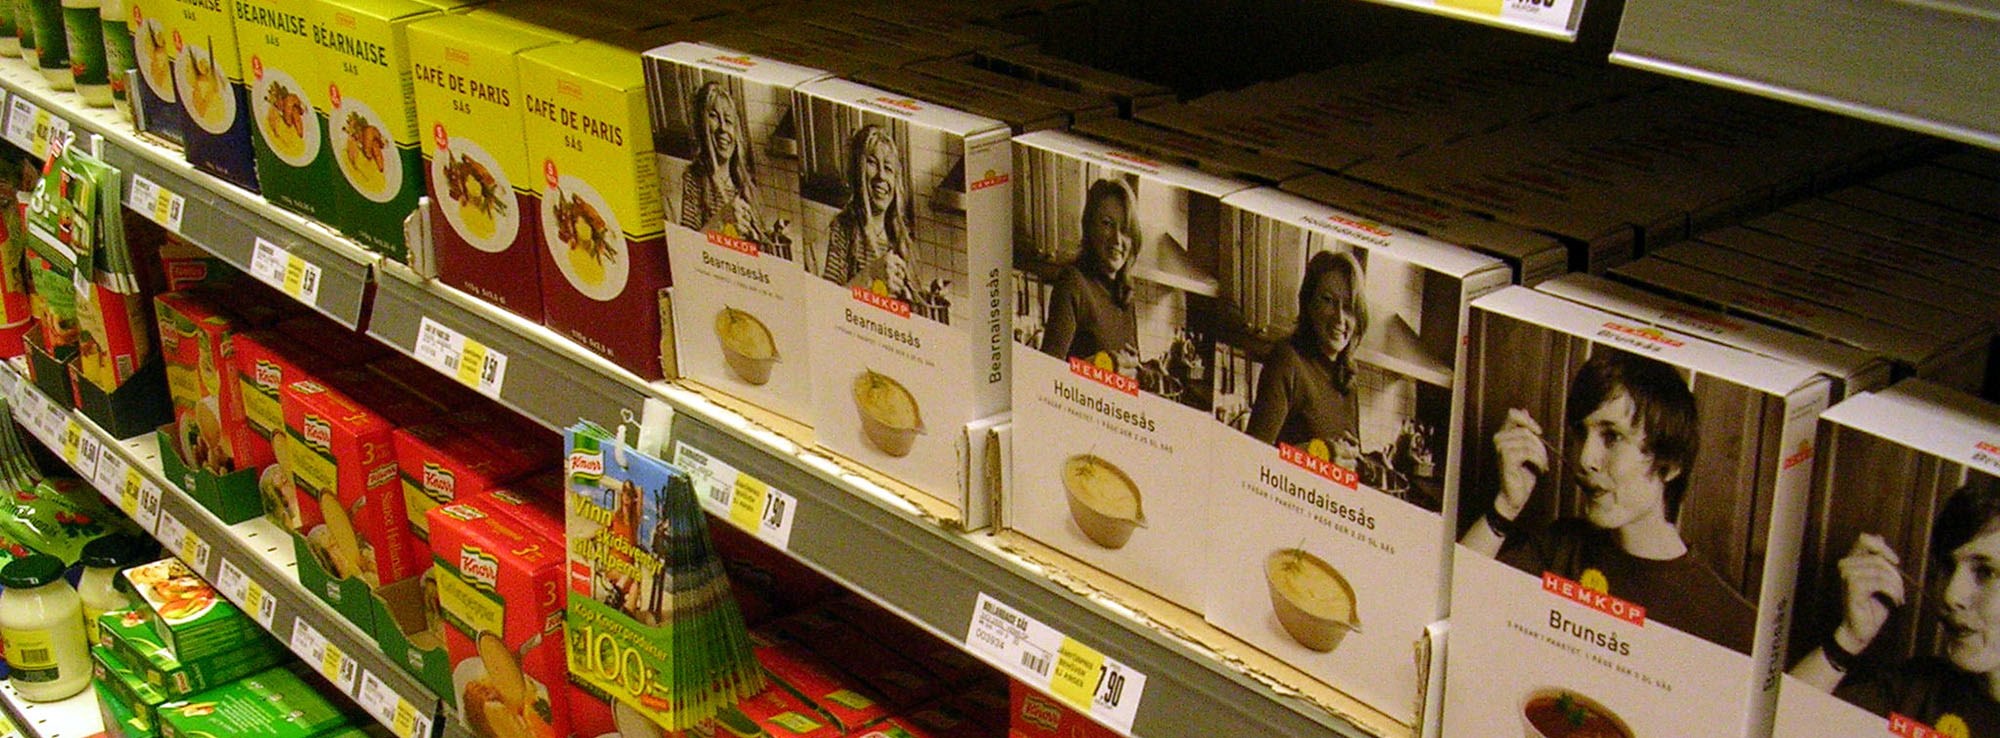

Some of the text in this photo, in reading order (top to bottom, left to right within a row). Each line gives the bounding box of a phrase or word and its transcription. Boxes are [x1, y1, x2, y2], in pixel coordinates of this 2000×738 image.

[312, 22, 388, 67] BÉARNAISE
[415, 64, 511, 108] CAFÉ DE PARIS
[526, 94, 624, 147] CAFÉ DE PARIS
[702, 250, 770, 284] Bearnaisesås
[845, 308, 921, 349] Bearnaisesås
[986, 267, 1002, 385] Bearnaisesås
[1054, 379, 1156, 432] Hollandaisesås
[571, 455, 601, 472] Knorr
[1281, 446, 1356, 484] HEMKÖP
[571, 492, 612, 528] Vinn
[1259, 465, 1376, 530] Hollandaisesås
[462, 556, 495, 580] Knorr
[1546, 577, 1641, 619] HEMKÖP
[1549, 609, 1631, 657] Brunsås
